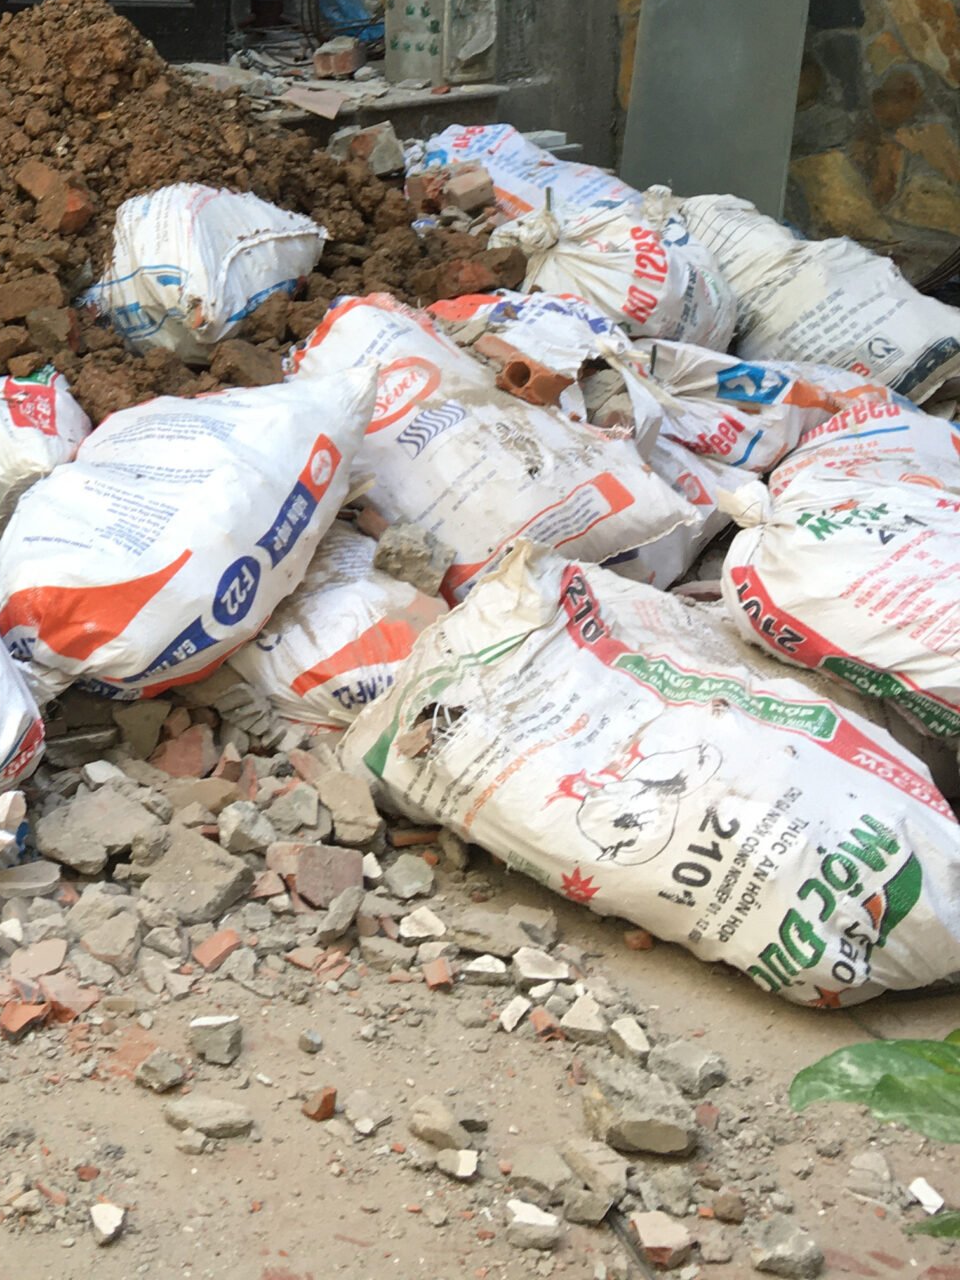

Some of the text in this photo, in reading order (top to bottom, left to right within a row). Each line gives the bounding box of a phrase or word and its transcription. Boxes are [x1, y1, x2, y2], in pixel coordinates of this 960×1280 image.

[219, 565, 256, 617] F22
[657, 805, 740, 909] 2101
[715, 817, 810, 942] THỨC ĂN HỖN HỢP
[733, 837, 760, 868] CÔNG
[797, 813, 905, 924] MỘC
